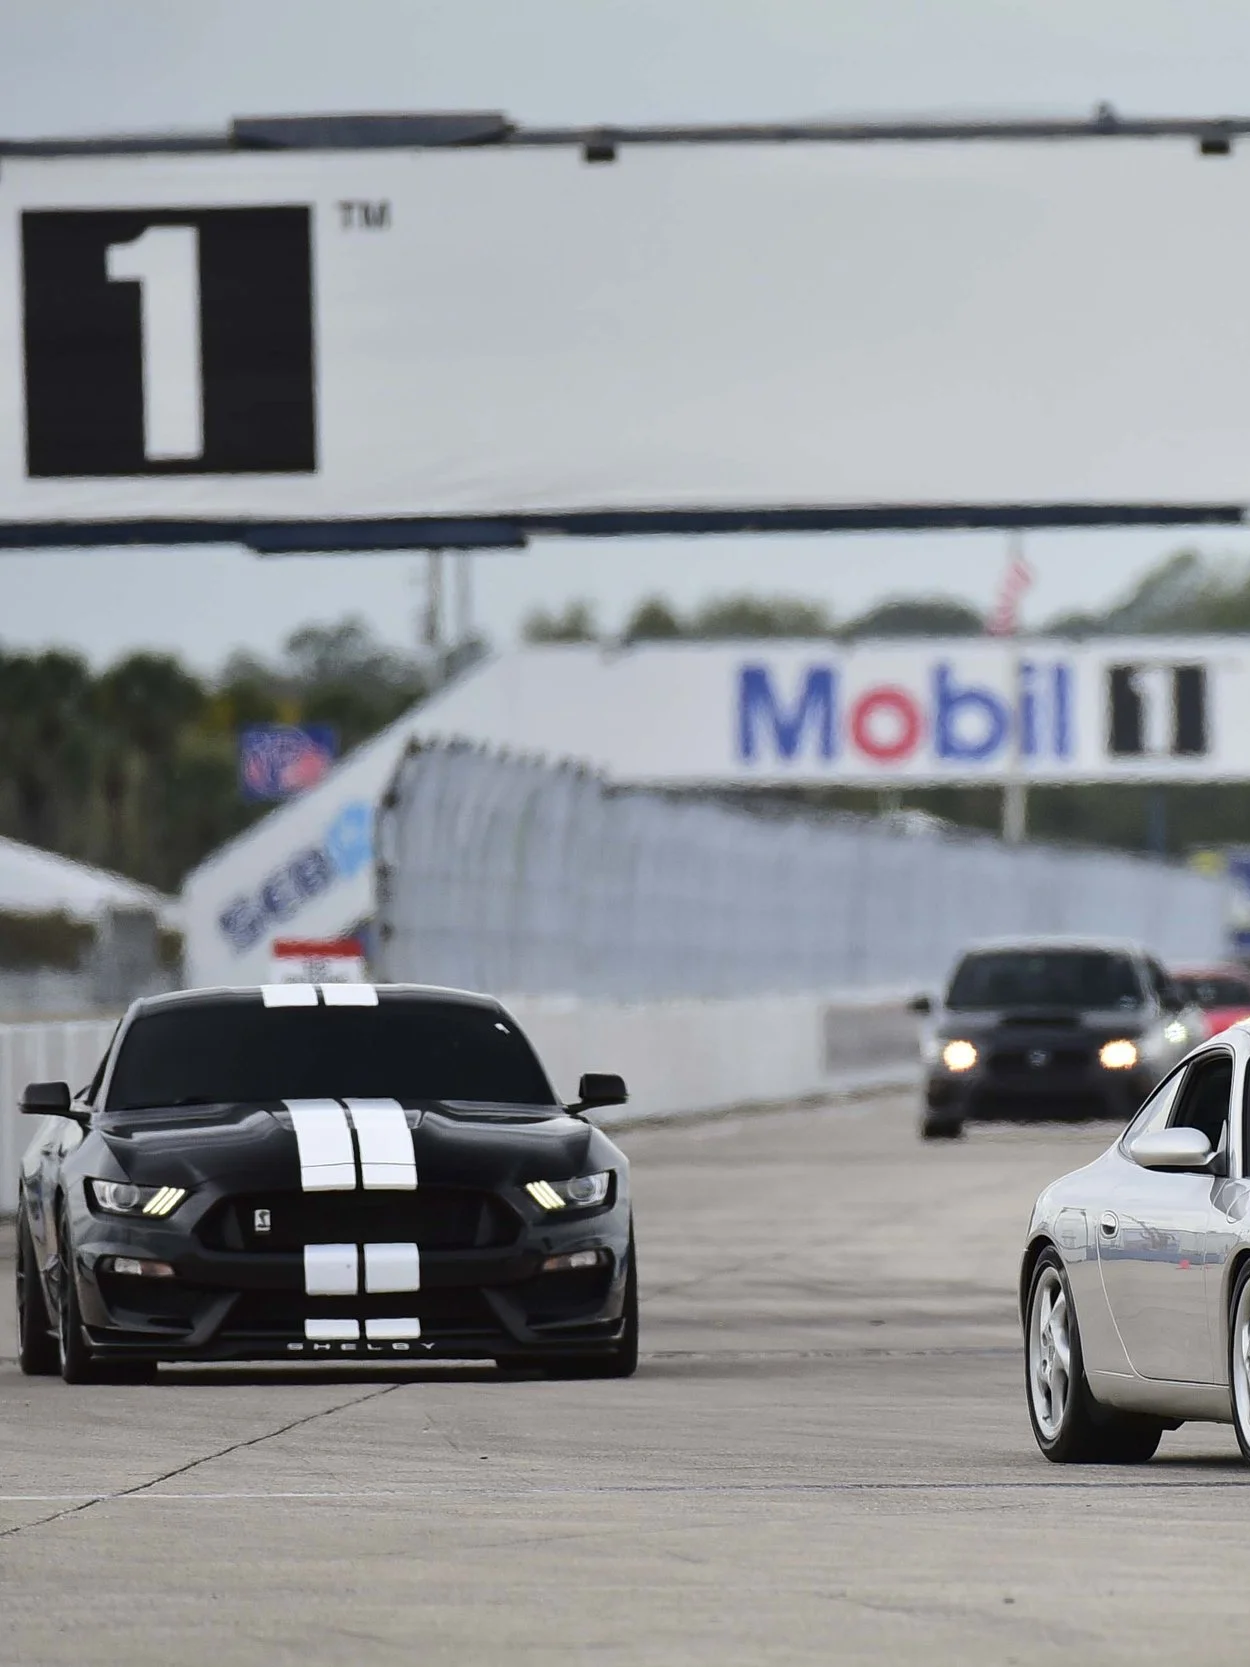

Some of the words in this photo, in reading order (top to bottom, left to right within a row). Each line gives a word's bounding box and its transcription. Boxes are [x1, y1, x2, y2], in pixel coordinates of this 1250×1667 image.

[106, 224, 204, 462] 1
[339, 201, 391, 229] TM
[738, 662, 1072, 764] Mobil
[286, 1342, 435, 1351] SHELBY
